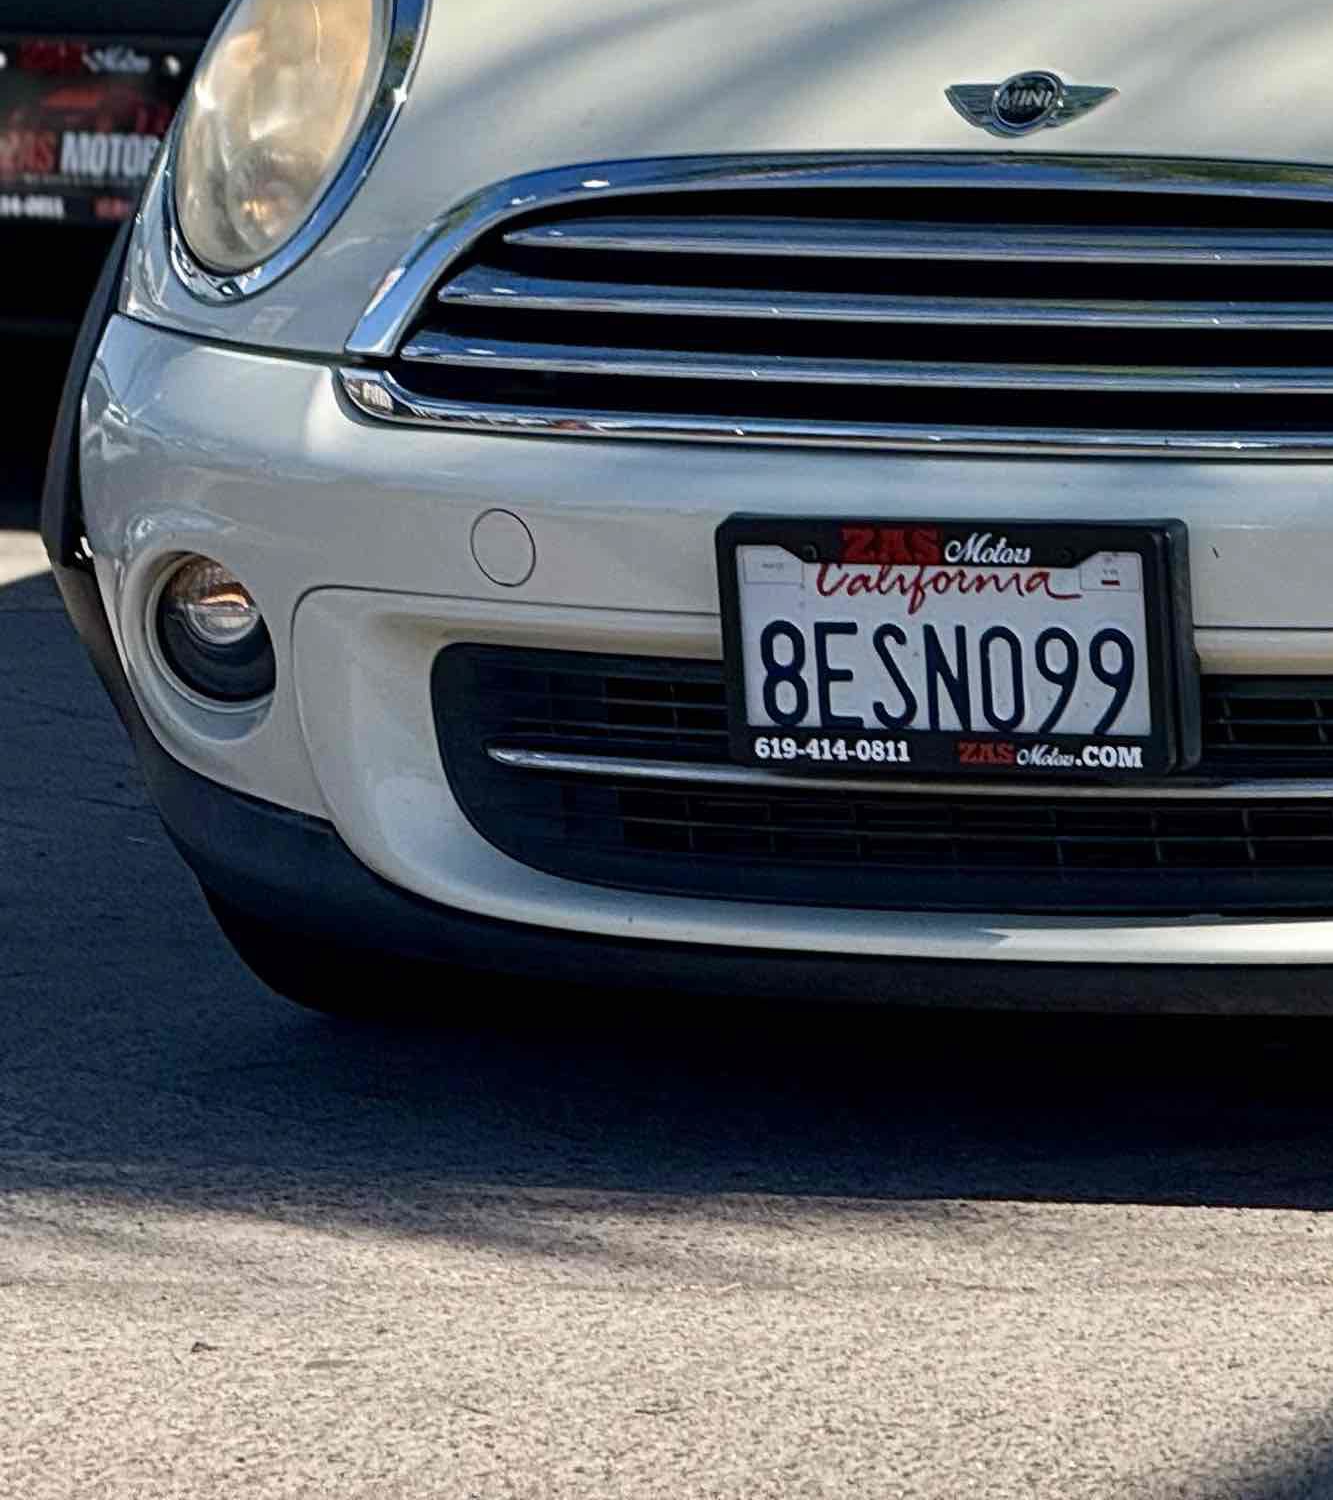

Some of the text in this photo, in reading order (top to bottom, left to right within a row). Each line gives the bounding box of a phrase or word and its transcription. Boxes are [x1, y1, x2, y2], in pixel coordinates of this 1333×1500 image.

[1000, 89, 1053, 109] MINI
[61, 132, 161, 178] MOTOR
[842, 528, 1032, 565] ZAS Motors
[815, 562, 1082, 615] California
[759, 619, 1136, 735] 8ESN099
[754, 737, 911, 763] 619-414-0811
